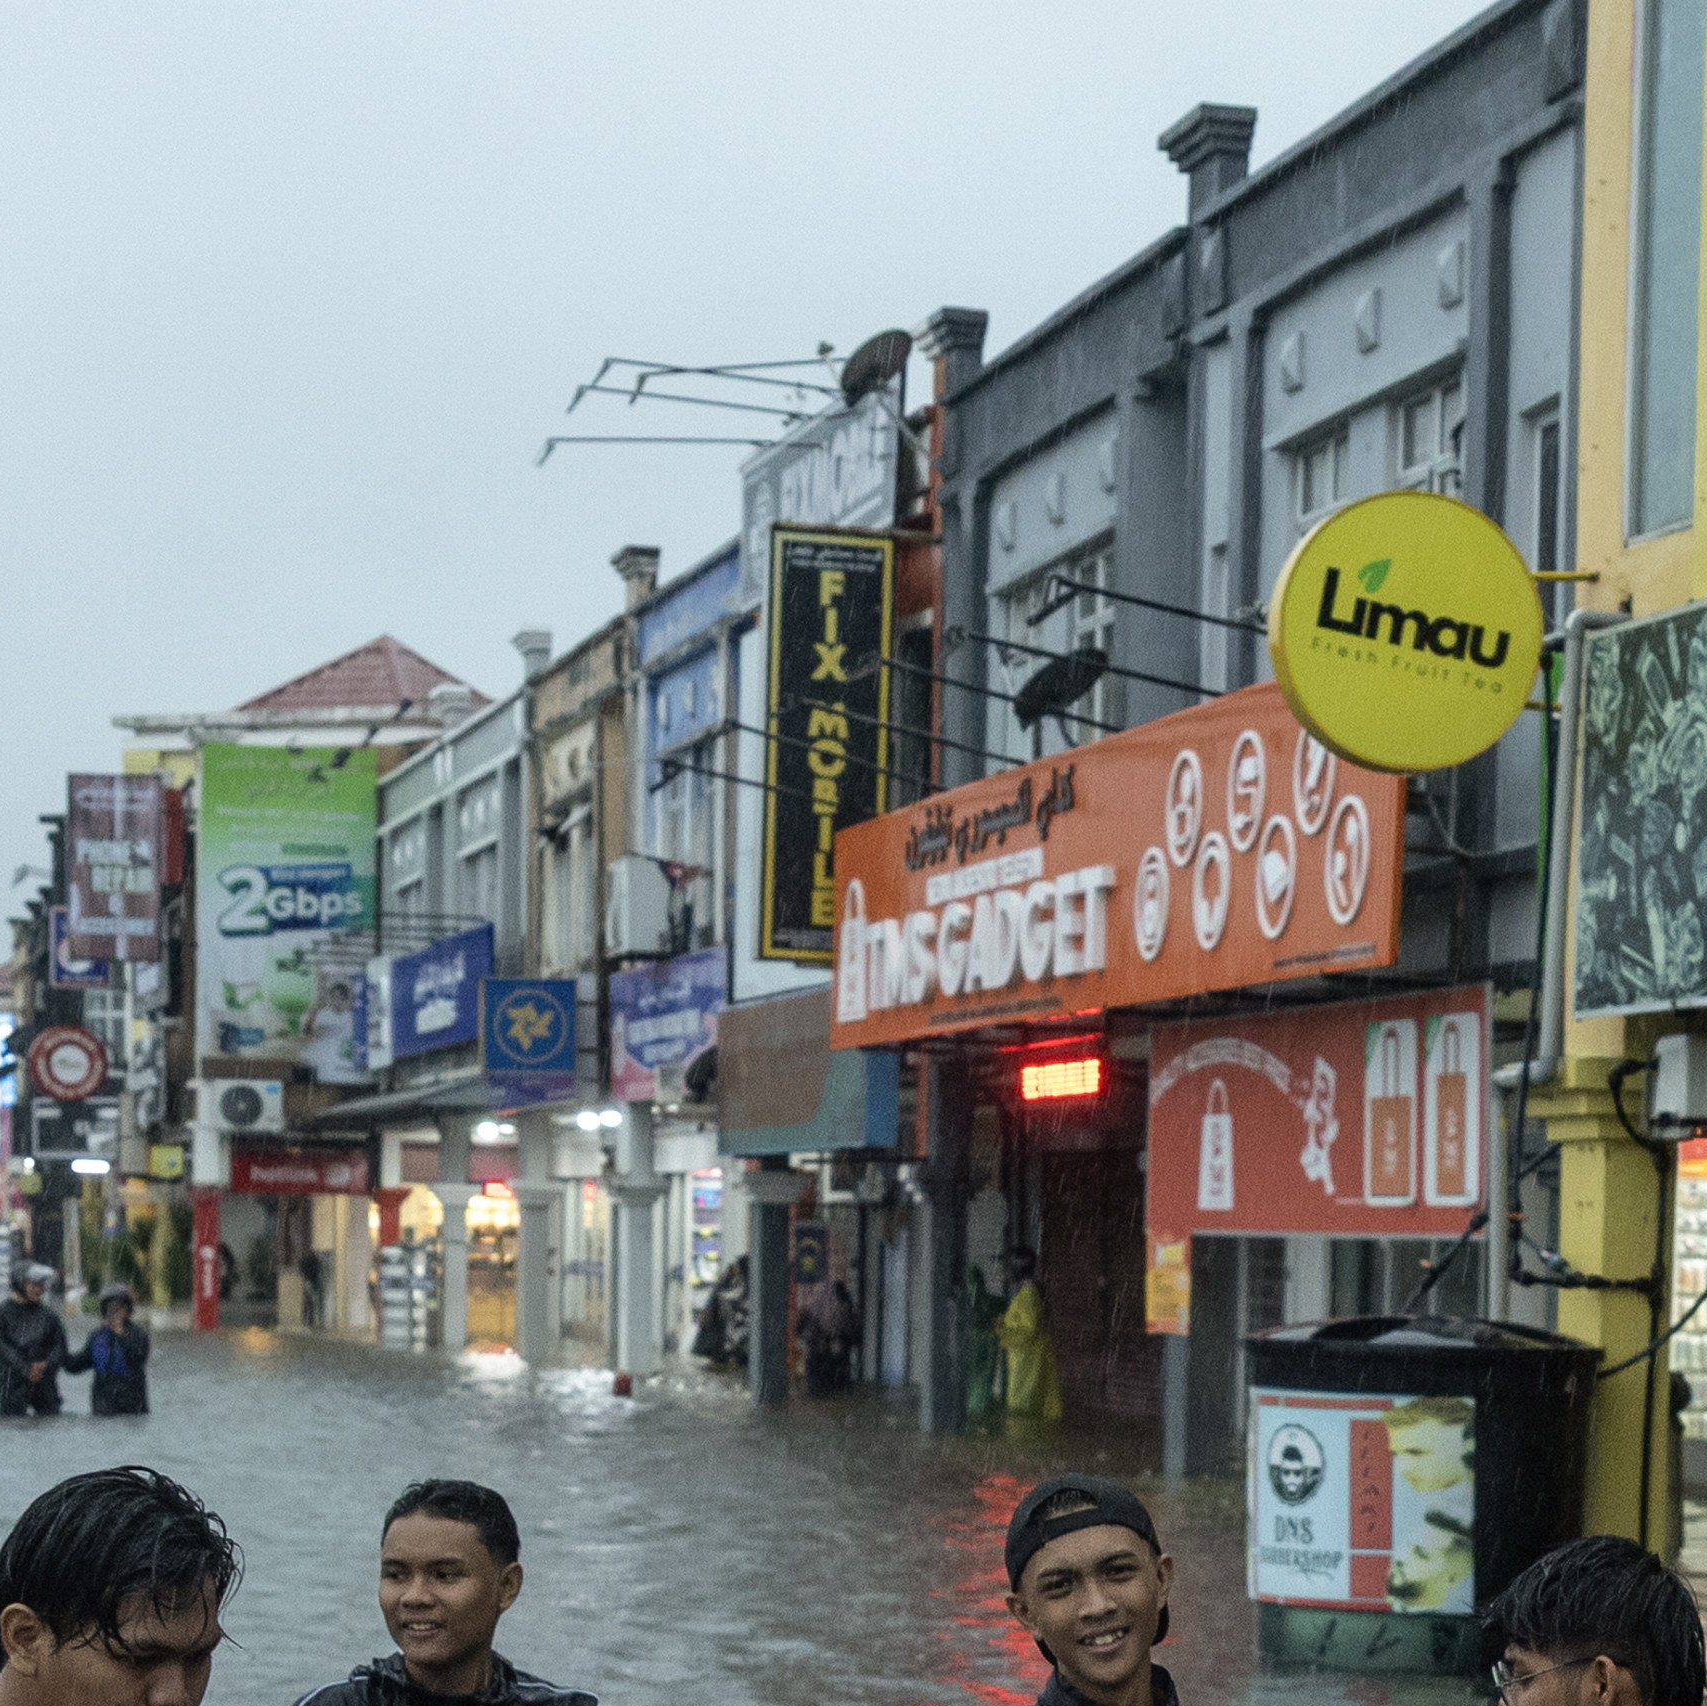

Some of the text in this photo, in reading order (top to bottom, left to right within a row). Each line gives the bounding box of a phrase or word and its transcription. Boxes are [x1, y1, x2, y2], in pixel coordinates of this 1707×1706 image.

[810, 569, 848, 682] FIX
[1311, 635, 1503, 695] Fresh Fruit Tea
[1316, 566, 1511, 669] Limau
[806, 701, 850, 927] MOBILE
[938, 863, 1116, 998] GADGET
[1274, 1515, 1313, 1545] DNS
